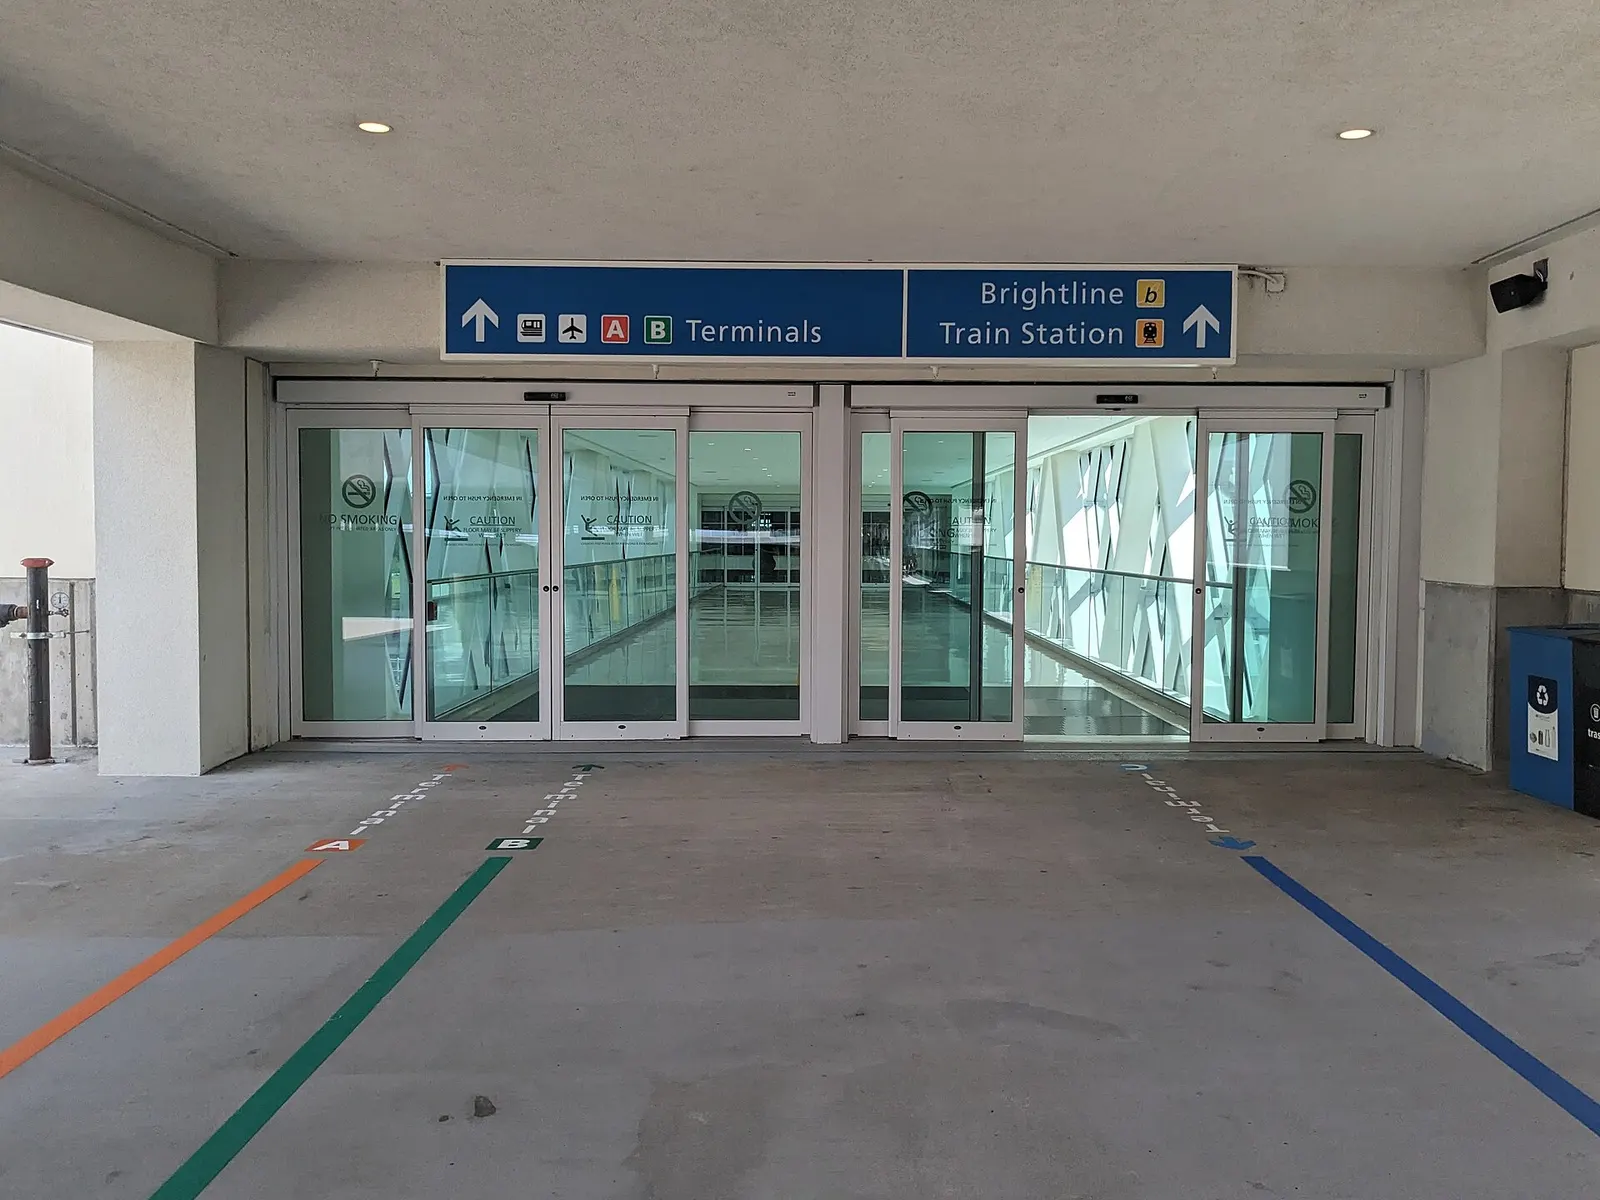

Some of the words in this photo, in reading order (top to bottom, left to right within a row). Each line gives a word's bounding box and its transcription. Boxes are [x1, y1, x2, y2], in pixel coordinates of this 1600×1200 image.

[981, 281, 1124, 311] Brightline
[1144, 286, 1158, 304] b
[605, 321, 626, 339] A
[650, 322, 667, 340] B
[685, 319, 822, 344] Terminals
[939, 322, 1010, 345] Train
[1021, 322, 1124, 345] Station
[340, 513, 398, 525] SMOKING
[469, 516, 516, 525] CAUTION
[606, 514, 652, 524] CAUTION
[1587, 727, 1600, 741] tras
[350, 773, 452, 836] Terminal
[522, 773, 592, 834] Terminal
[1141, 773, 1231, 834] Terminal
[311, 840, 350, 852] A
[496, 839, 531, 850] B
